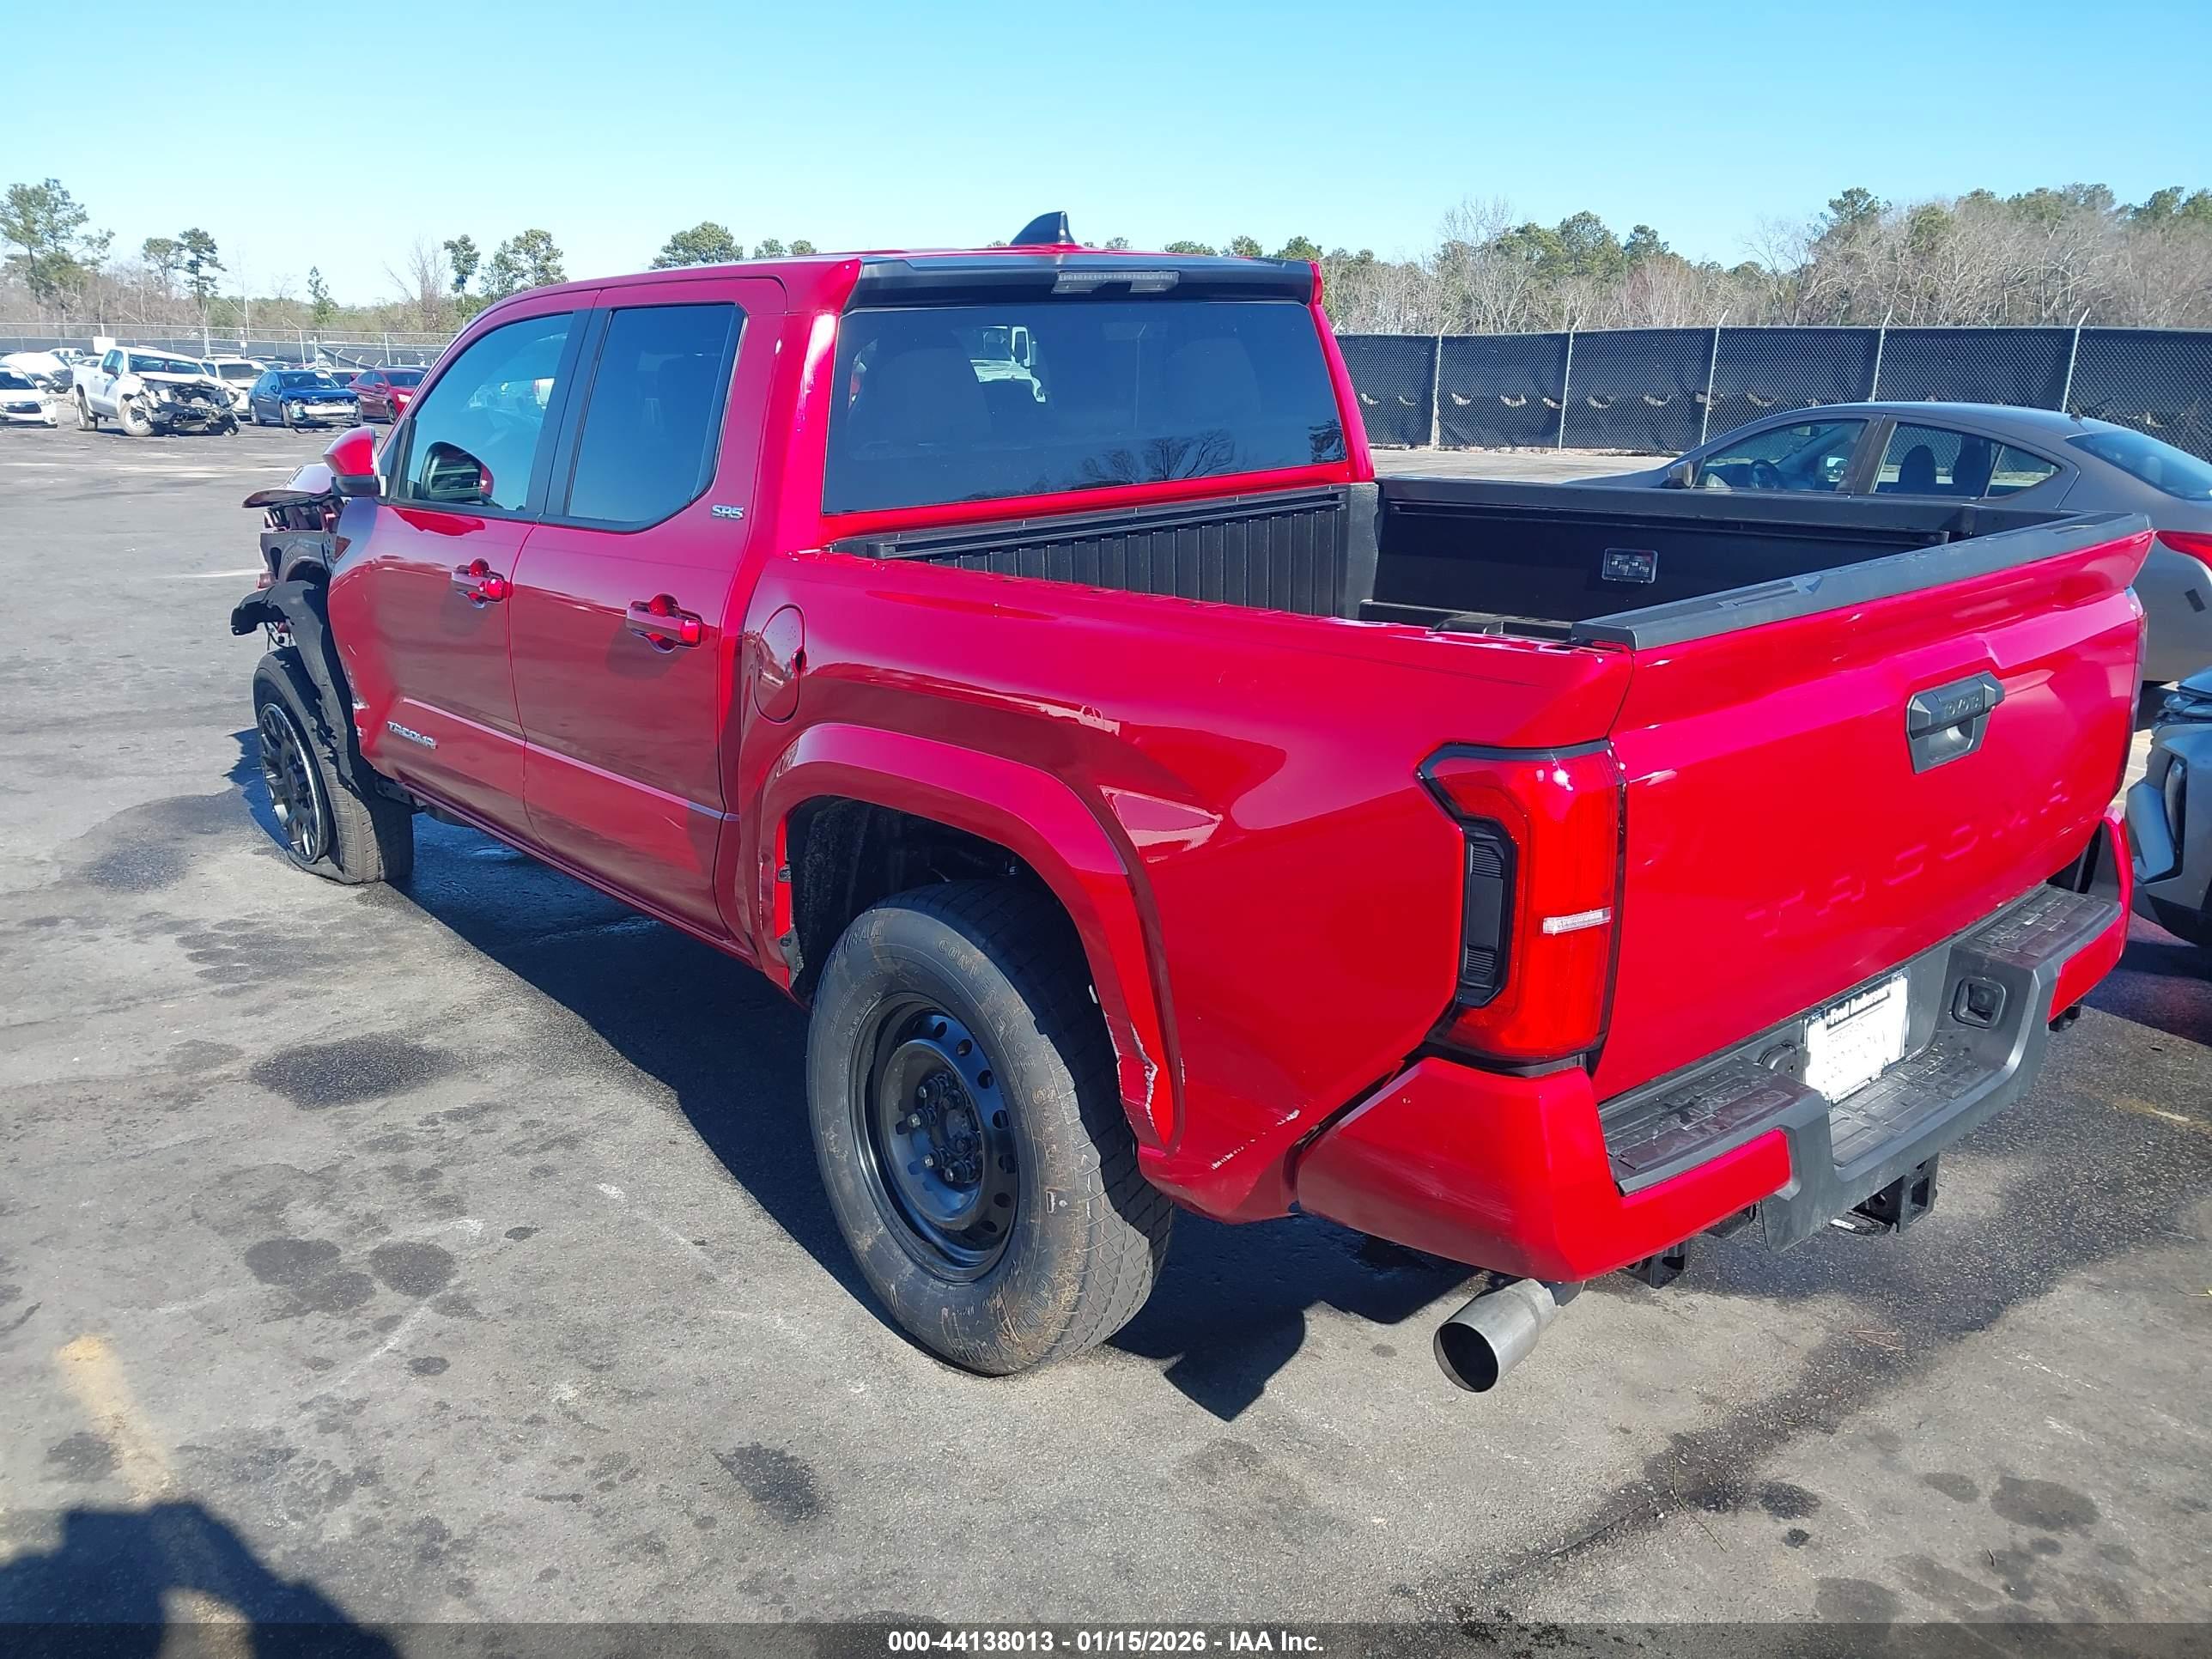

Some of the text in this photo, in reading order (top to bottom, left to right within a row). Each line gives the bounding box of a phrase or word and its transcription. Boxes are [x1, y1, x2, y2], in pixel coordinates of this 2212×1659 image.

[711, 504, 744, 520] SR5
[387, 721, 439, 750] TACOMA
[1744, 780, 2070, 939] TACOMA
